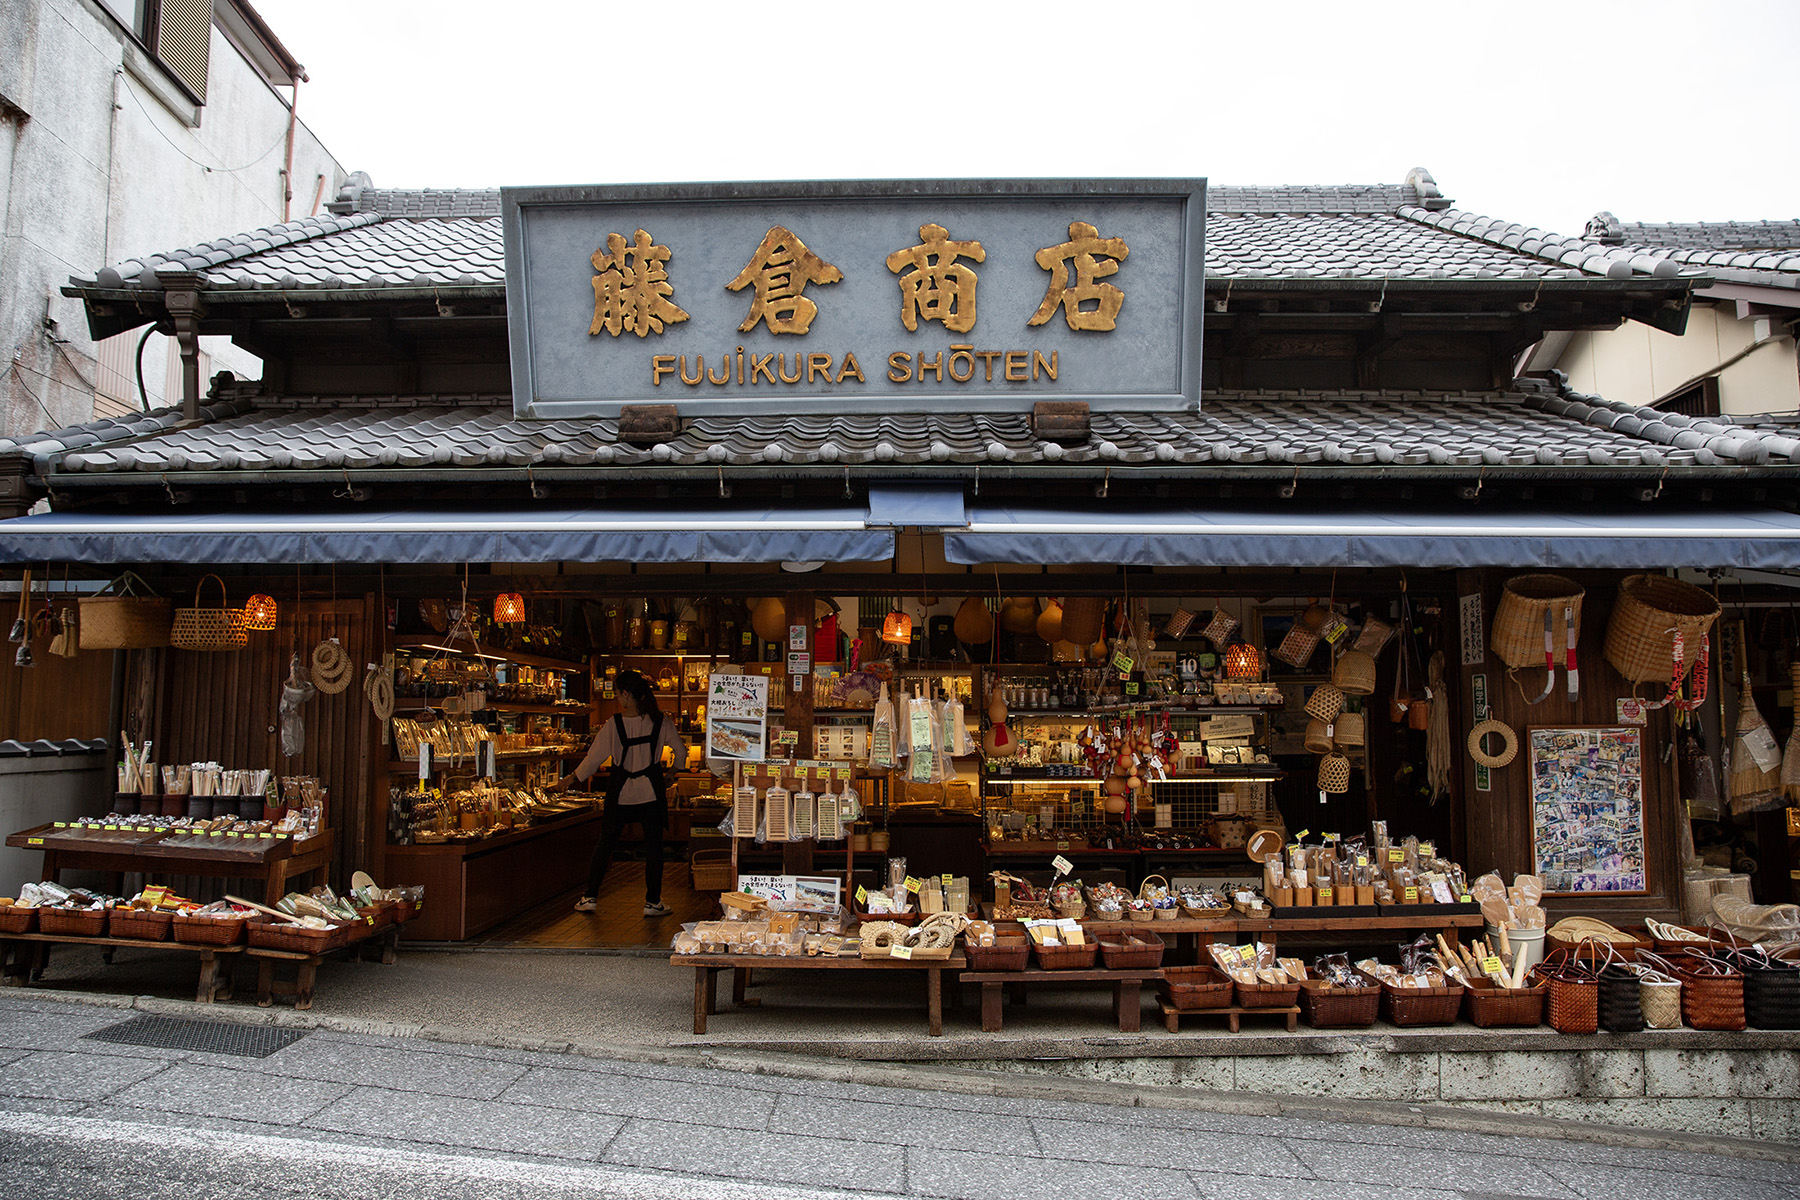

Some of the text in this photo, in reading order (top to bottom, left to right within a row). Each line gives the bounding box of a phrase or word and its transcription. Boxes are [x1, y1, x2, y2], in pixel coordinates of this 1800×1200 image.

[589, 221, 1132, 337] 藤倉商店
[1180, 659, 1197, 673] 10
